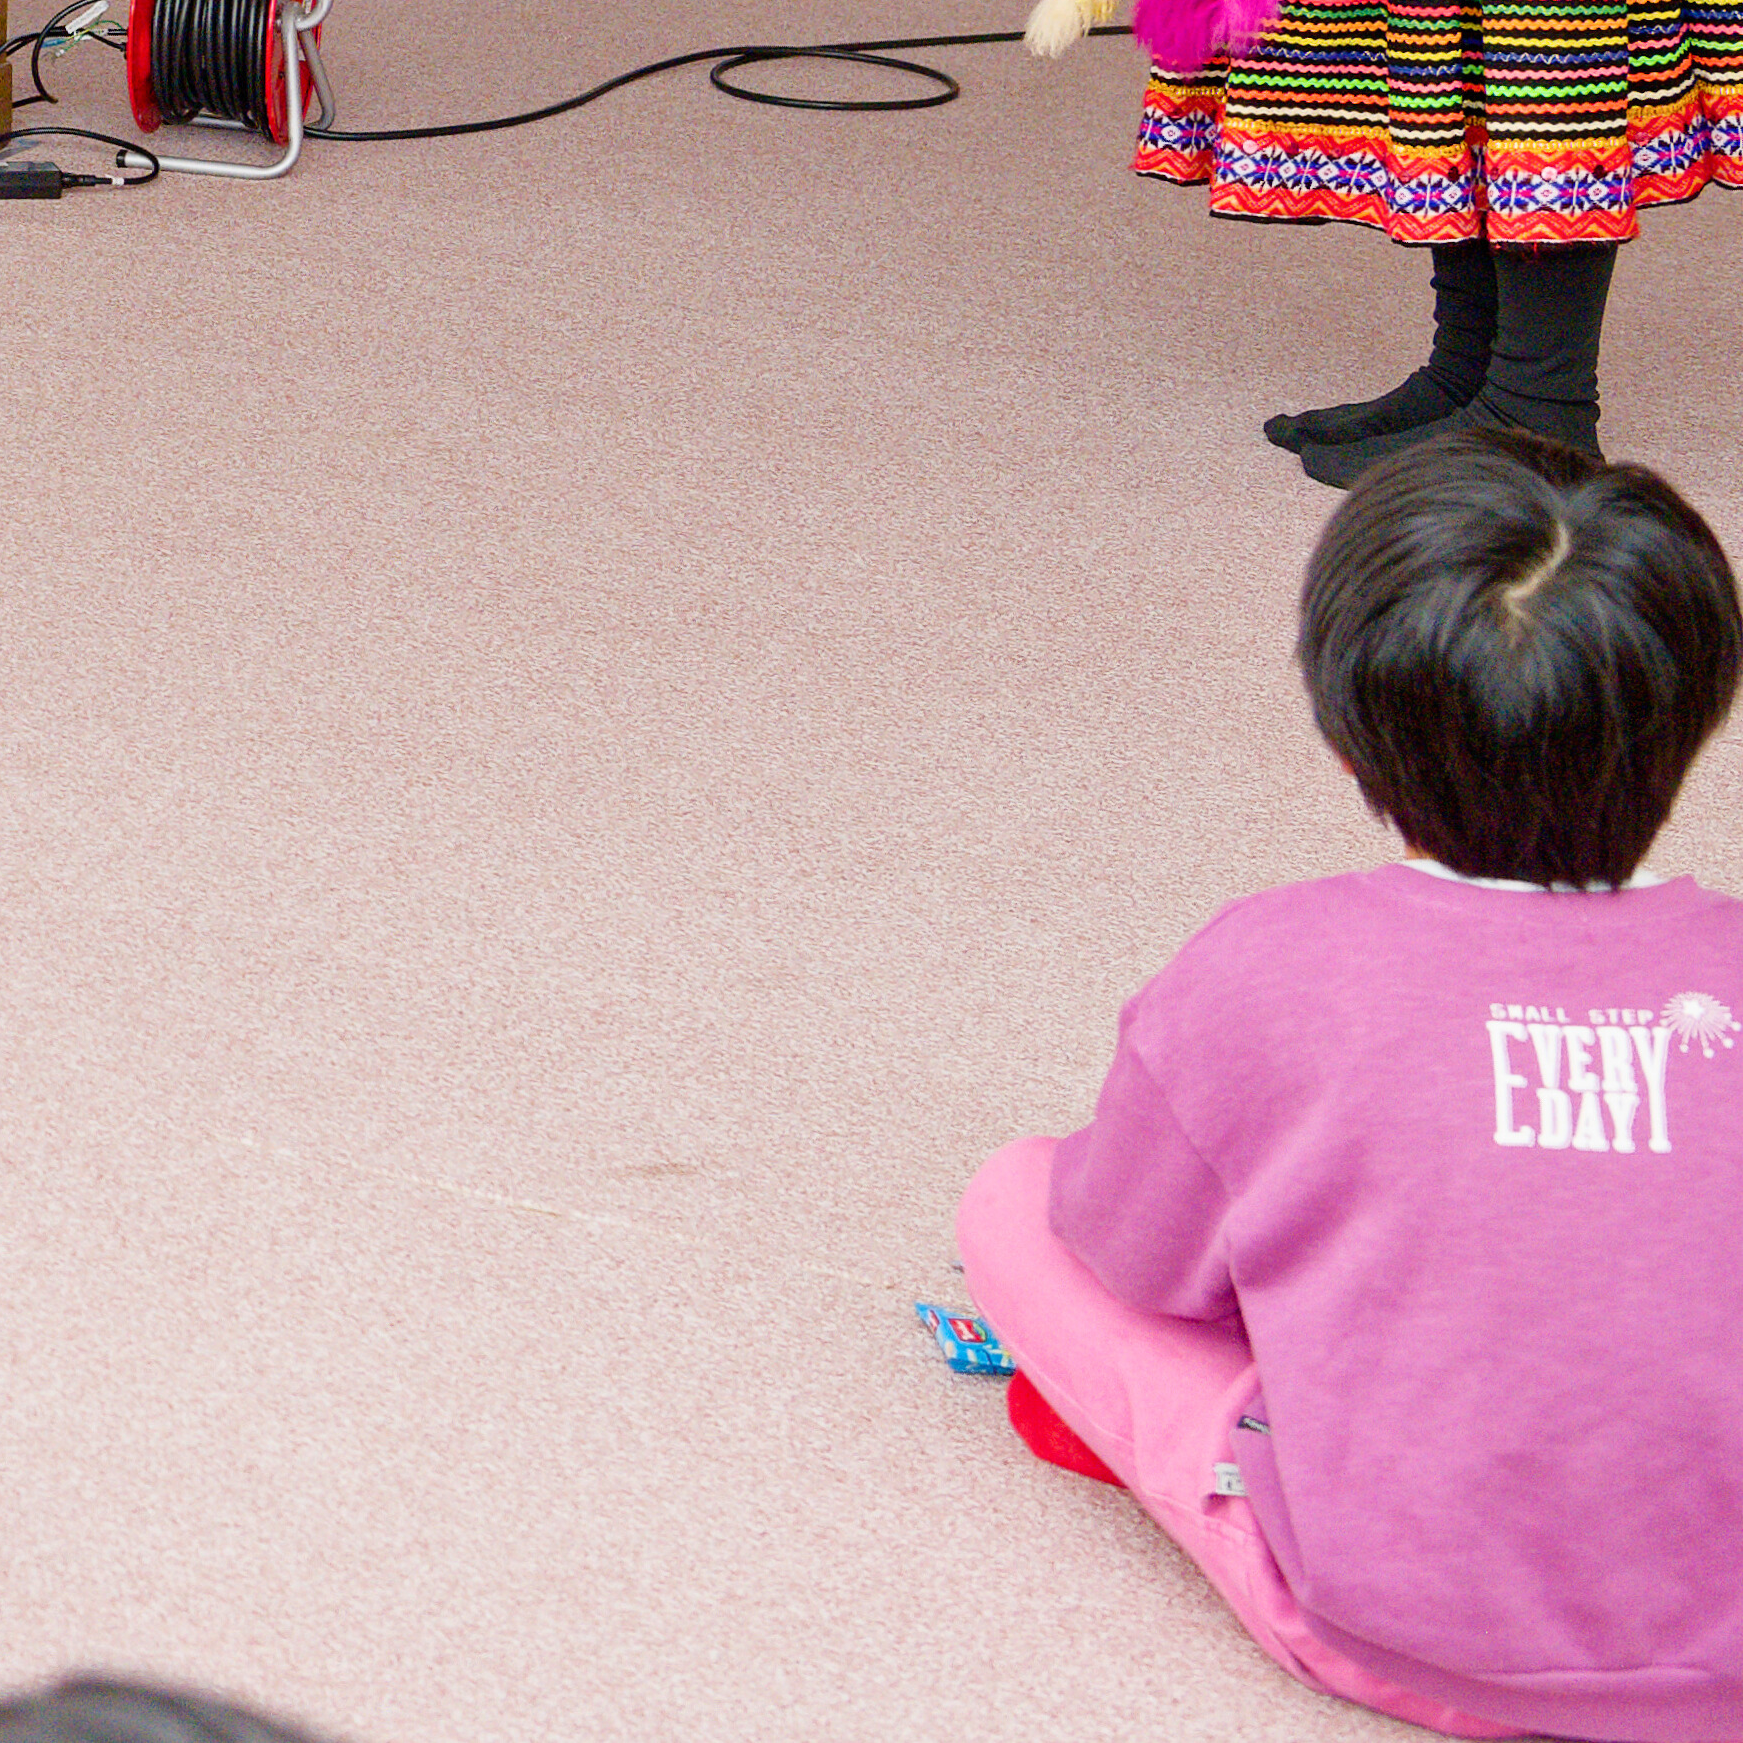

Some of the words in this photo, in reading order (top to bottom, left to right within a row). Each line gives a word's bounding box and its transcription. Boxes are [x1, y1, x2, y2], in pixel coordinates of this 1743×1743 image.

[1489, 1002, 1570, 1024] SMALL
[1588, 1008, 1654, 1025] STEP
[1535, 1088, 1640, 1153] DAY
